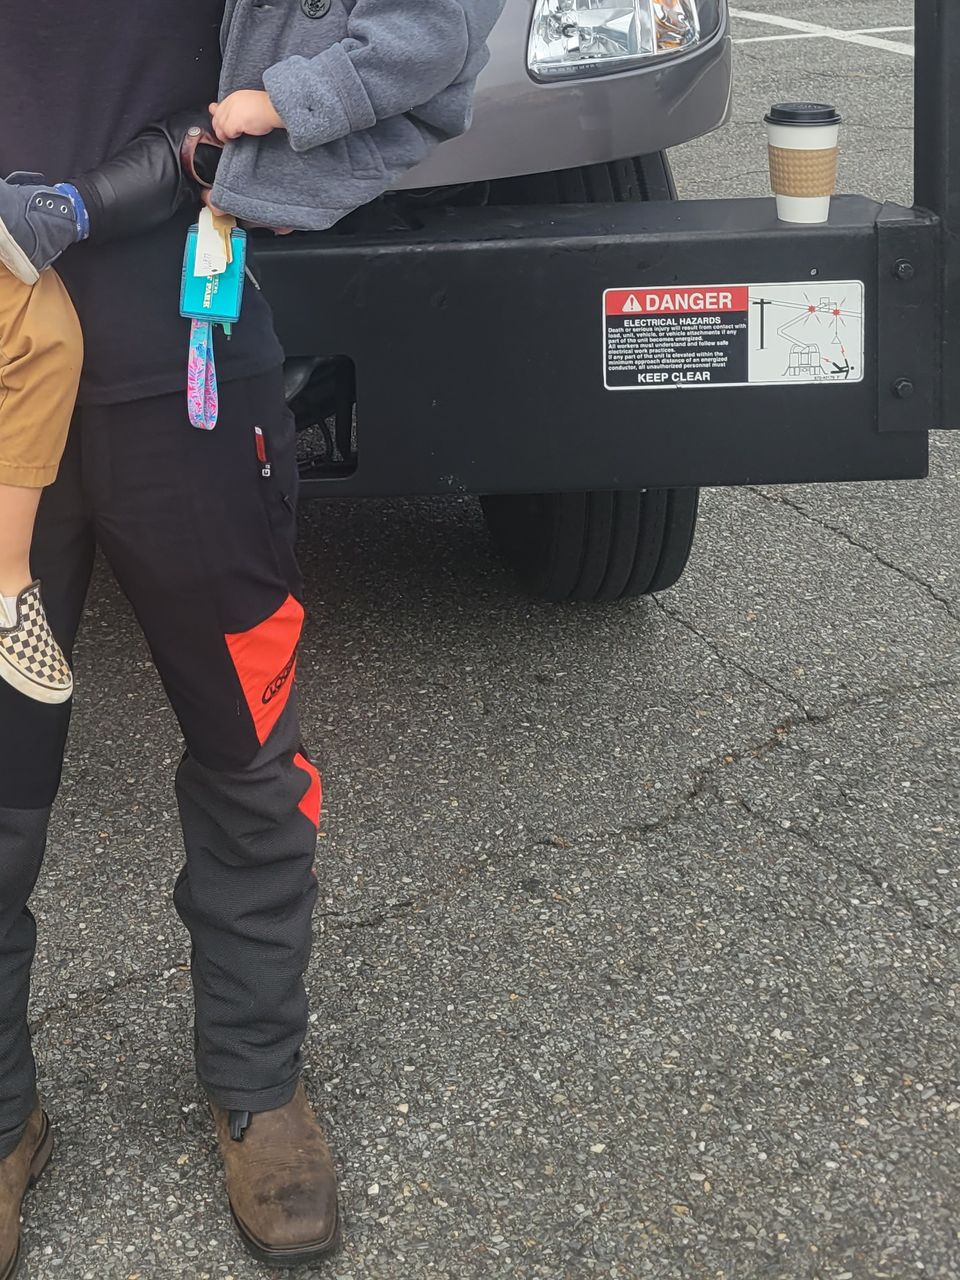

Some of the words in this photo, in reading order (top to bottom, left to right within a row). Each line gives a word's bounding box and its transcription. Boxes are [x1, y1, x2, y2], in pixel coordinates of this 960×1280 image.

[646, 292, 732, 311] DANGER
[624, 318, 678, 327] ELECTRICAL
[679, 317, 721, 325] HAZARDS
[638, 373, 669, 383] KEEP
[671, 371, 711, 382] CLEAR
